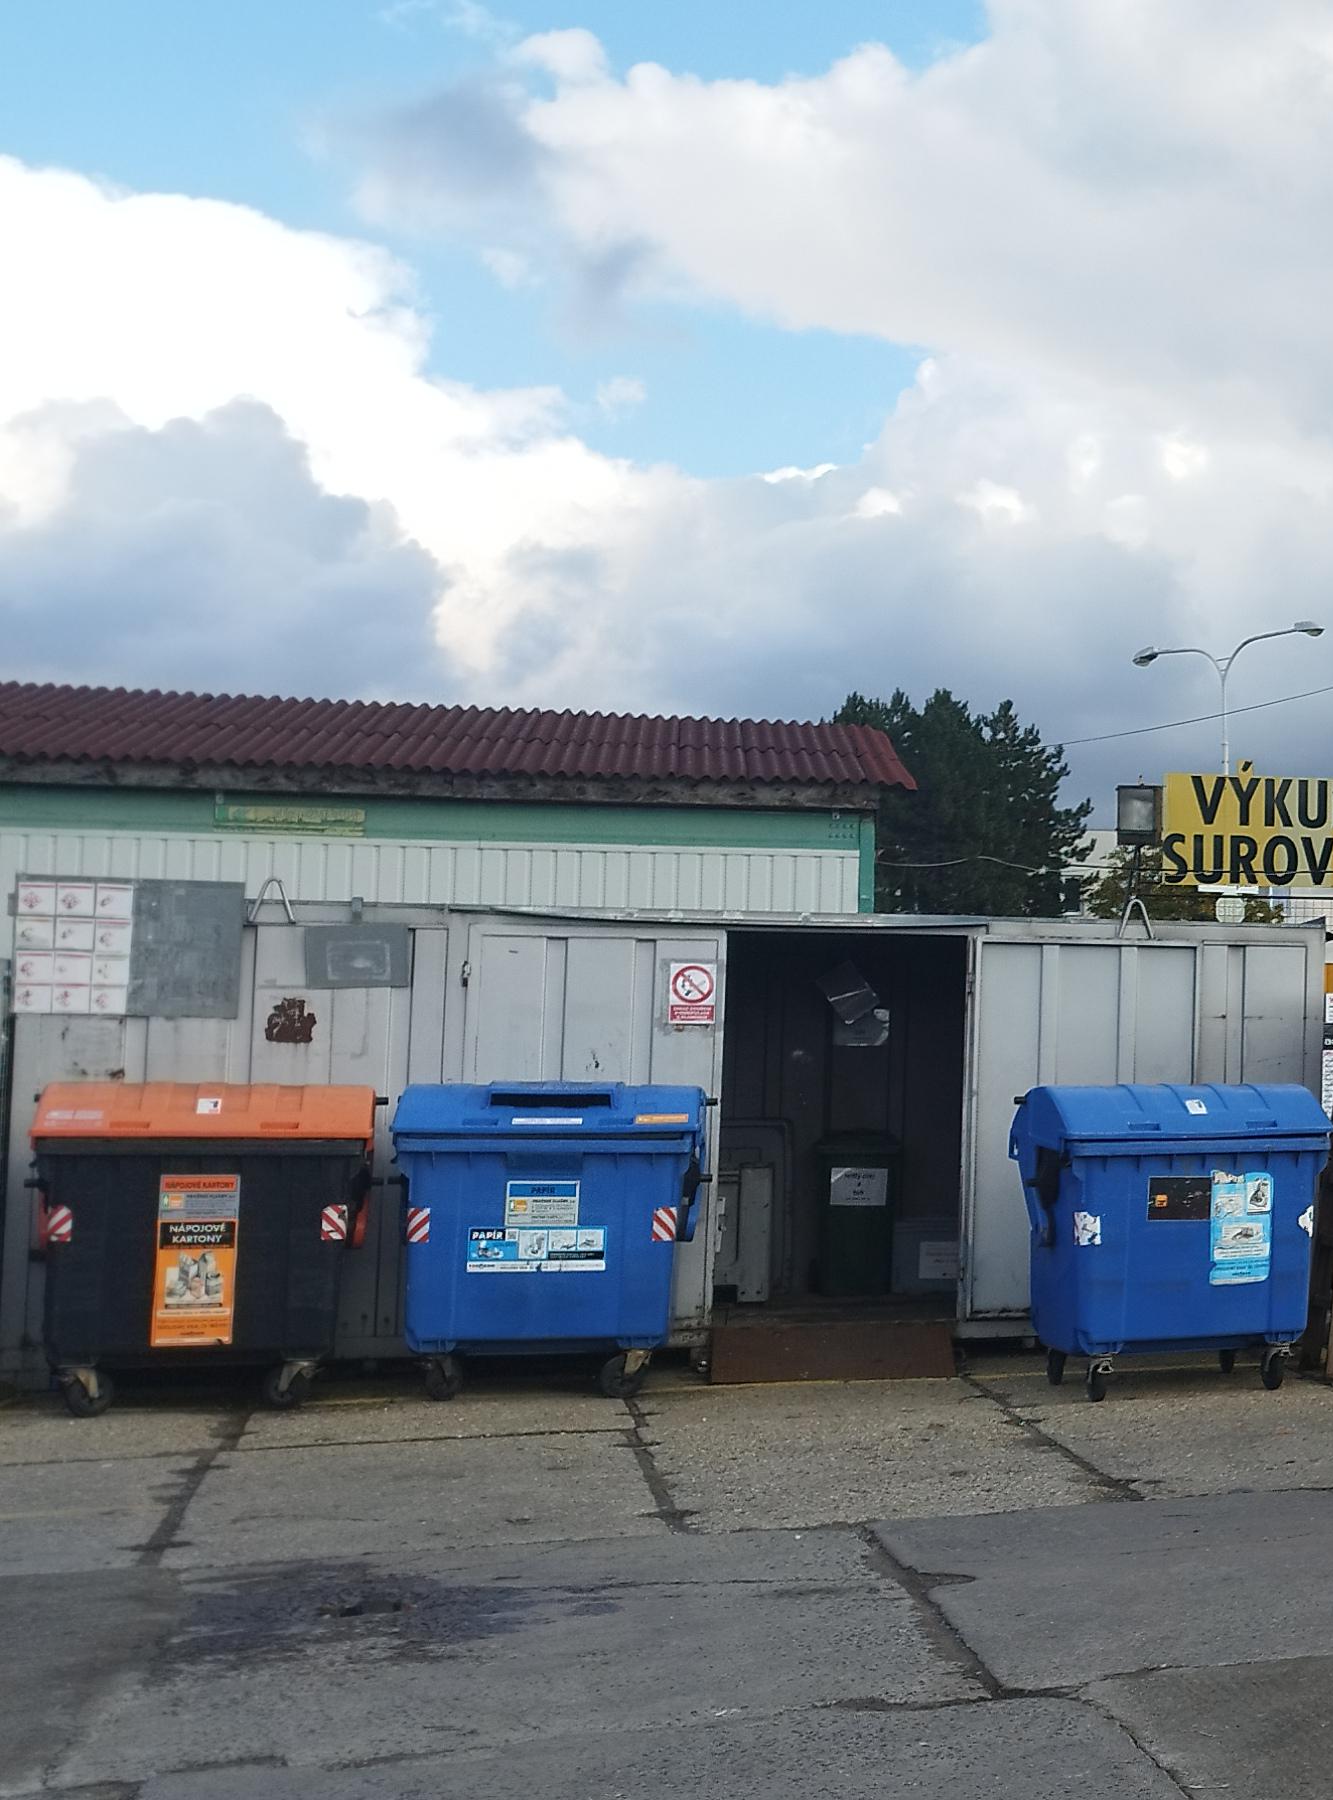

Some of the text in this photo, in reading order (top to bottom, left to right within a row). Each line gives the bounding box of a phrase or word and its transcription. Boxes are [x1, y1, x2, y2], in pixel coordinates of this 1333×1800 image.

[169, 1222, 226, 1233] NÁPOJOVÉ
[172, 1235, 222, 1244] KARTONY
[472, 1229, 503, 1240] PAPÍR
